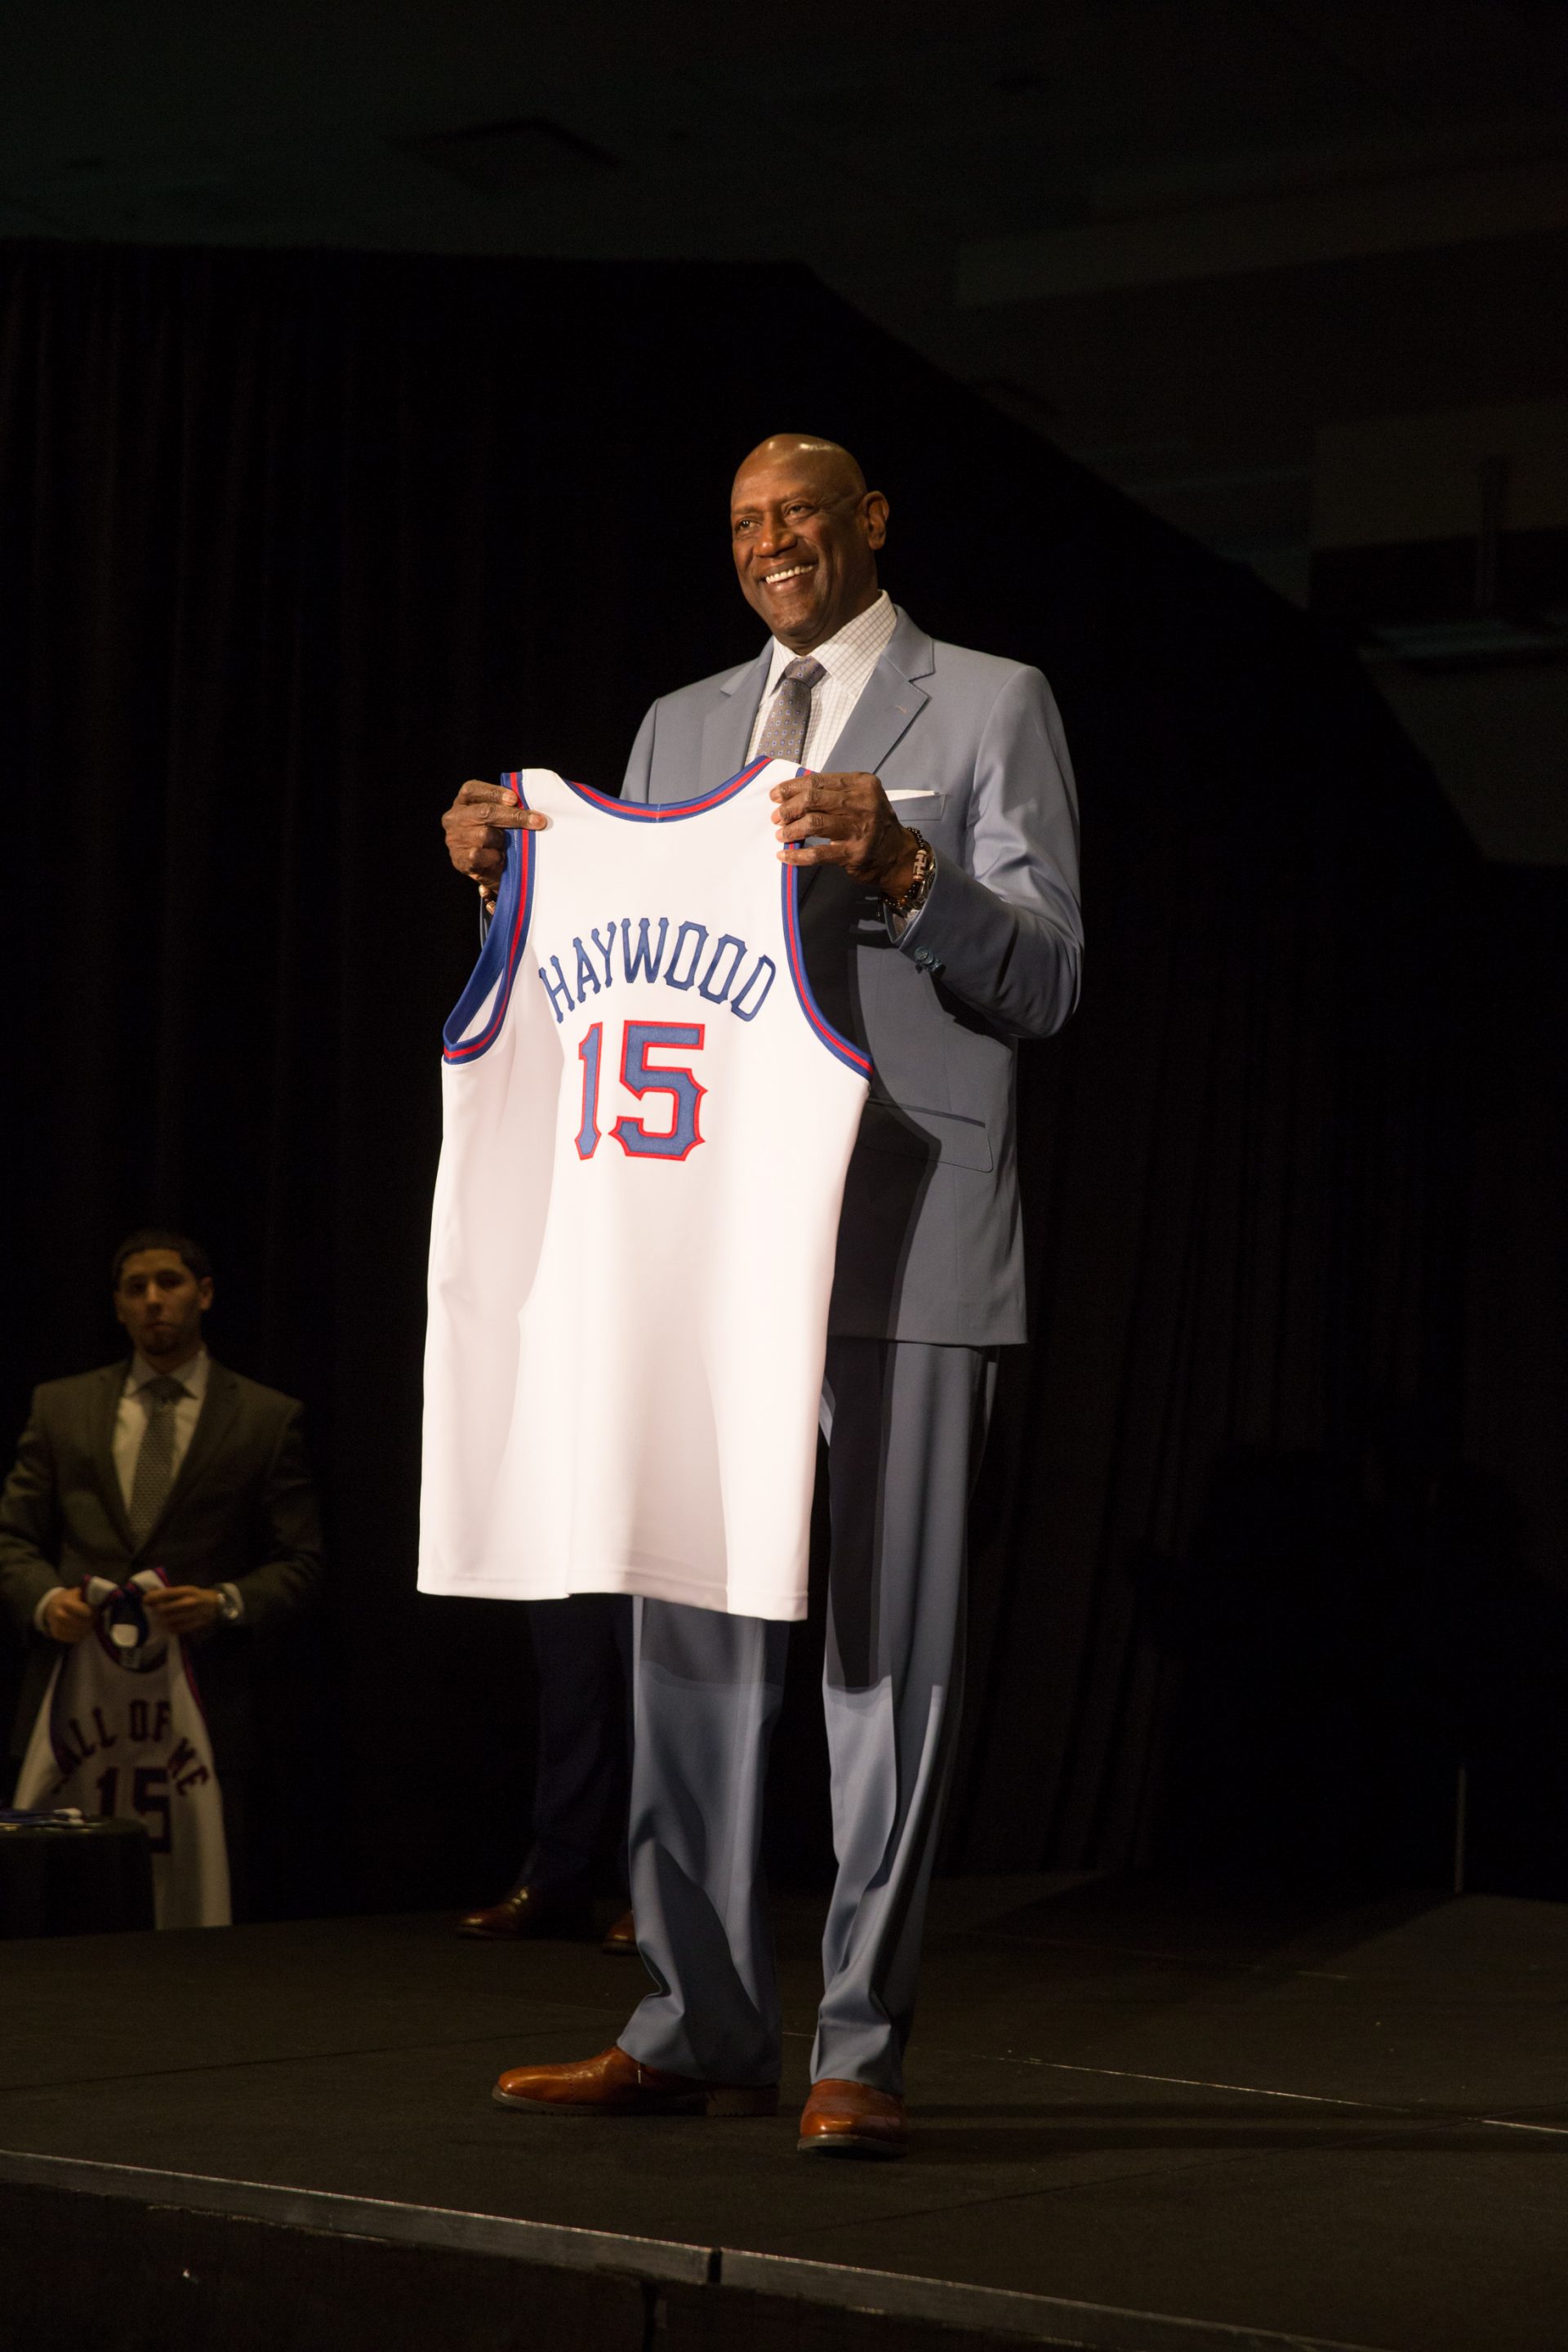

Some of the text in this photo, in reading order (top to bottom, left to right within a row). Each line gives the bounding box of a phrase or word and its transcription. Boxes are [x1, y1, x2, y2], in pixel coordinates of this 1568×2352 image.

[538, 917, 776, 1023] HAYWOOD
[574, 1020, 708, 1161] 15
[96, 1766, 170, 1853] 15
